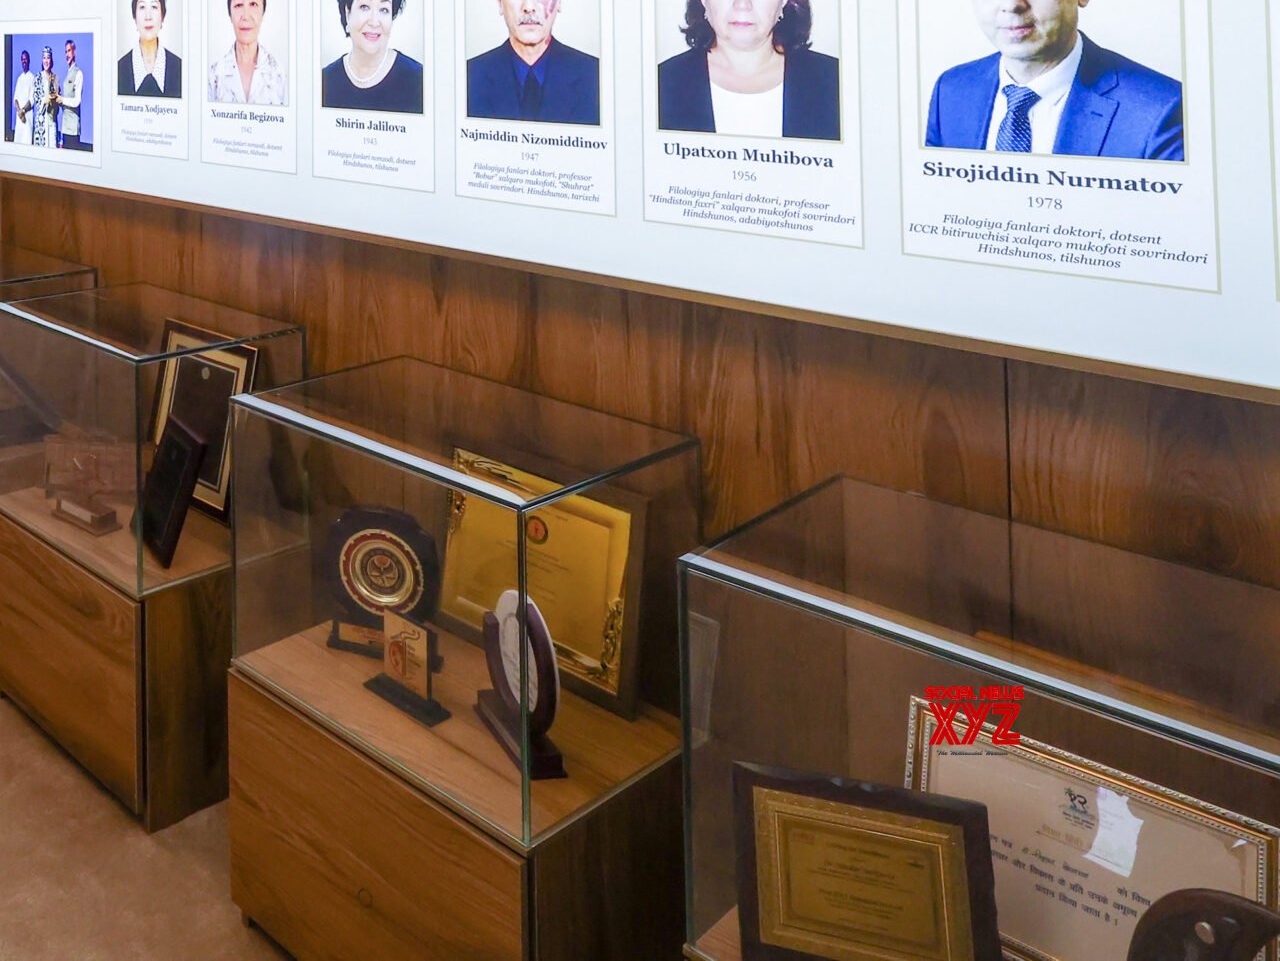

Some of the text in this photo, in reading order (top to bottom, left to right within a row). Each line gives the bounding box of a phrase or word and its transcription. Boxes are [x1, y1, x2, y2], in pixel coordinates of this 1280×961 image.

[336, 118, 406, 133] Shirin Jalilova
[460, 128, 608, 150] Najmiddin Nizomiddinov
[521, 152, 540, 161] 1947
[664, 143, 834, 168] Ulpatxon Muhibova
[473, 162, 592, 182] Filologiya fanlari doktori, professor
[732, 170, 757, 182] 1956
[922, 161, 1183, 195] Sirojiddin Nurmatov
[571, 193, 600, 203] tarixchi
[668, 186, 830, 211] Filologiya fanlari doktori, professor
[1027, 196, 1063, 210] 1978
[683, 208, 814, 232] Hindshunos, adabiyotshunos
[721, 203, 756, 215] xalqaro
[758, 207, 800, 221] mukofoti
[802, 212, 856, 225] sovrindori
[942, 214, 1162, 245] Filologiya fanlari doktori, dotsent
[909, 222, 1208, 264] ICCR bitiruvchisi xalqaro mukofoti sovrindori
[977, 243, 1121, 268] Hindshunos, tilshunos
